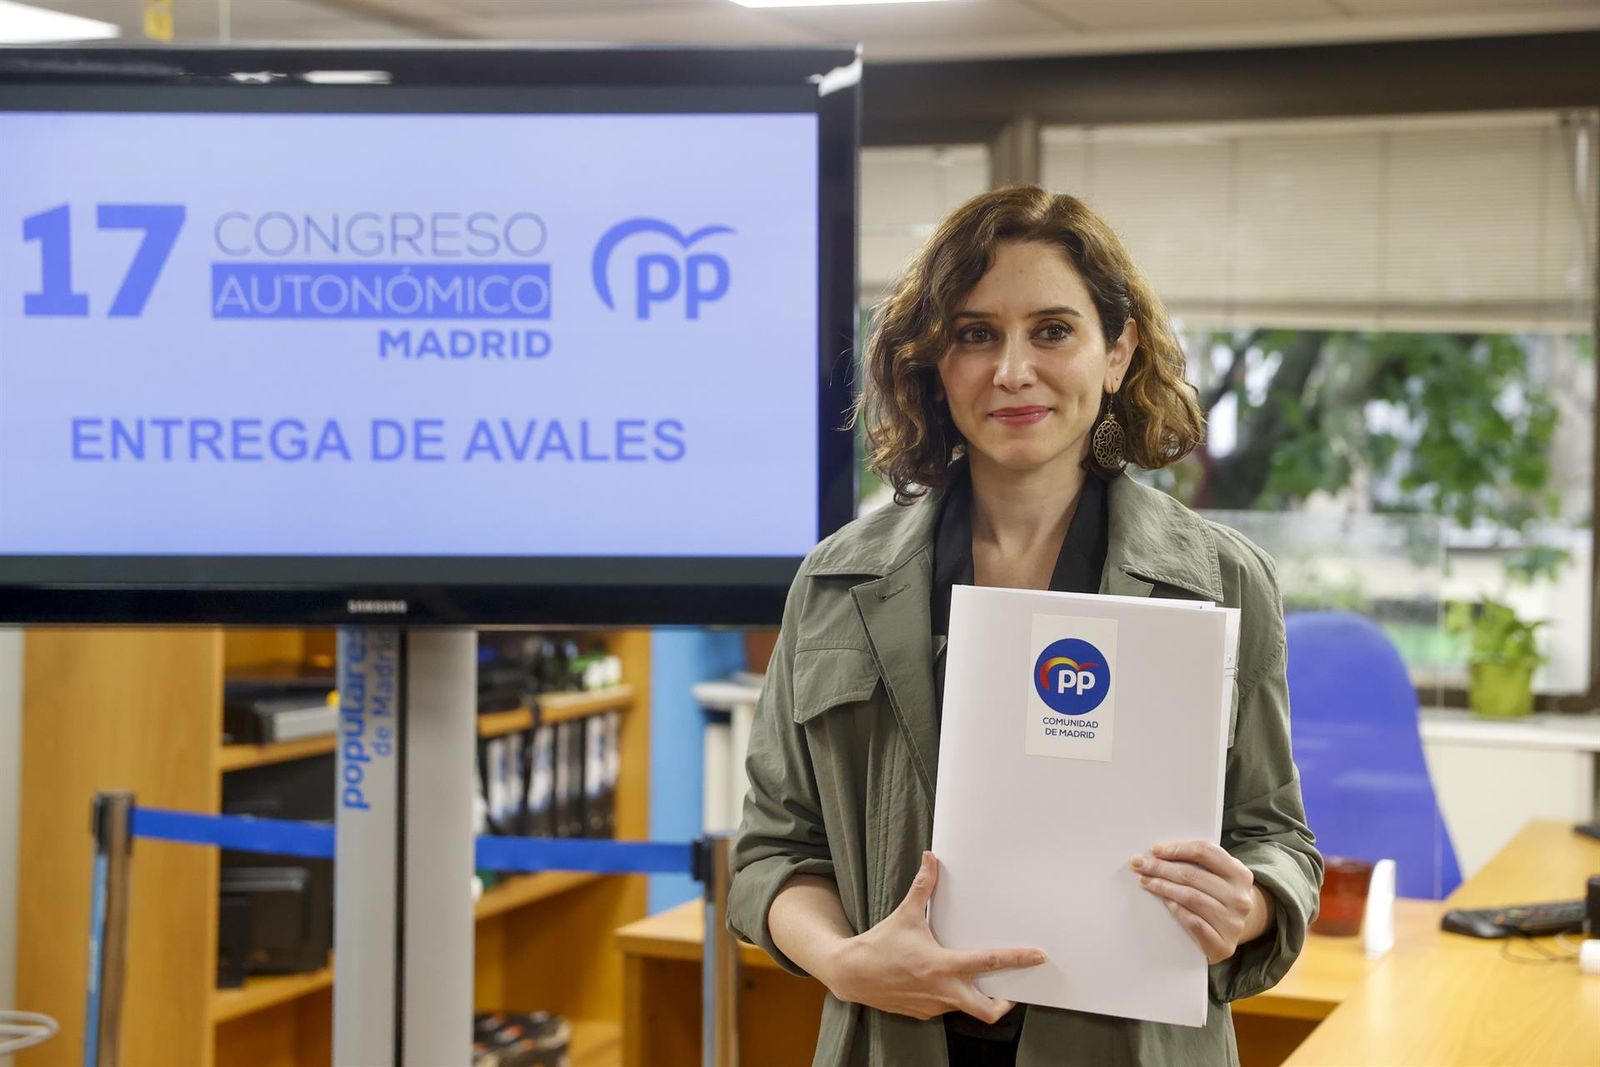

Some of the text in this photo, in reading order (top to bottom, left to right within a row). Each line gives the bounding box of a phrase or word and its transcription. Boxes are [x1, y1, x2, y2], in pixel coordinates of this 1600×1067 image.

[213, 211, 548, 257] CONGRESO
[22, 202, 188, 318] 17
[215, 269, 550, 315] AUTONÓMICO
[378, 330, 553, 359] MADRID
[71, 418, 687, 462] ENTREGA DE AVALES
[347, 600, 408, 614] SAMSUNG
[1042, 717, 1099, 728] COMUNIDAD
[1045, 728, 1095, 739] DE MADRID
[372, 726, 393, 757] de
